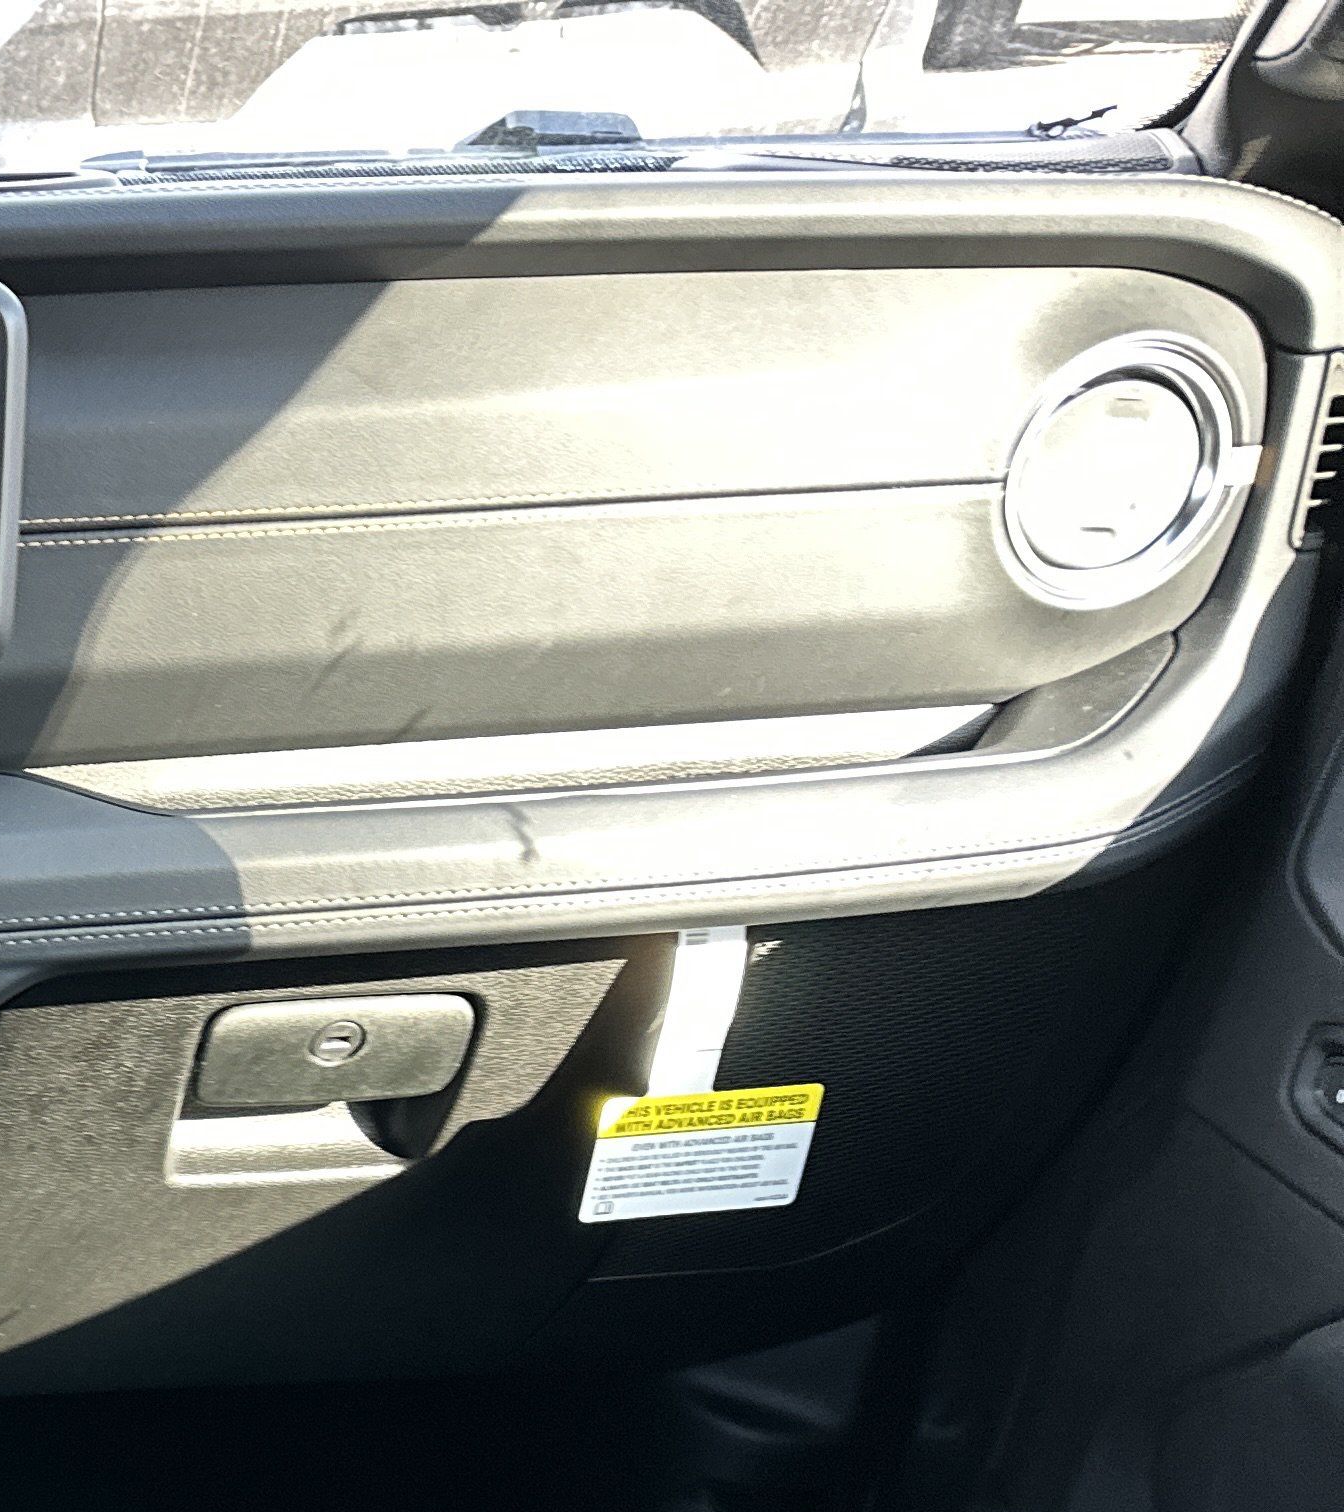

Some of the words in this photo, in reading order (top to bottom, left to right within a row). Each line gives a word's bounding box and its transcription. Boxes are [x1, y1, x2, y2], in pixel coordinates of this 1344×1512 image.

[655, 1100, 715, 1116] VEHICLE
[718, 1099, 734, 1111] IS
[736, 1094, 810, 1109] EQUIPPED
[616, 1119, 652, 1133] WITH
[654, 1114, 736, 1130] ADVANCED
[738, 1111, 763, 1123] AIR
[766, 1108, 806, 1121] BAGS
